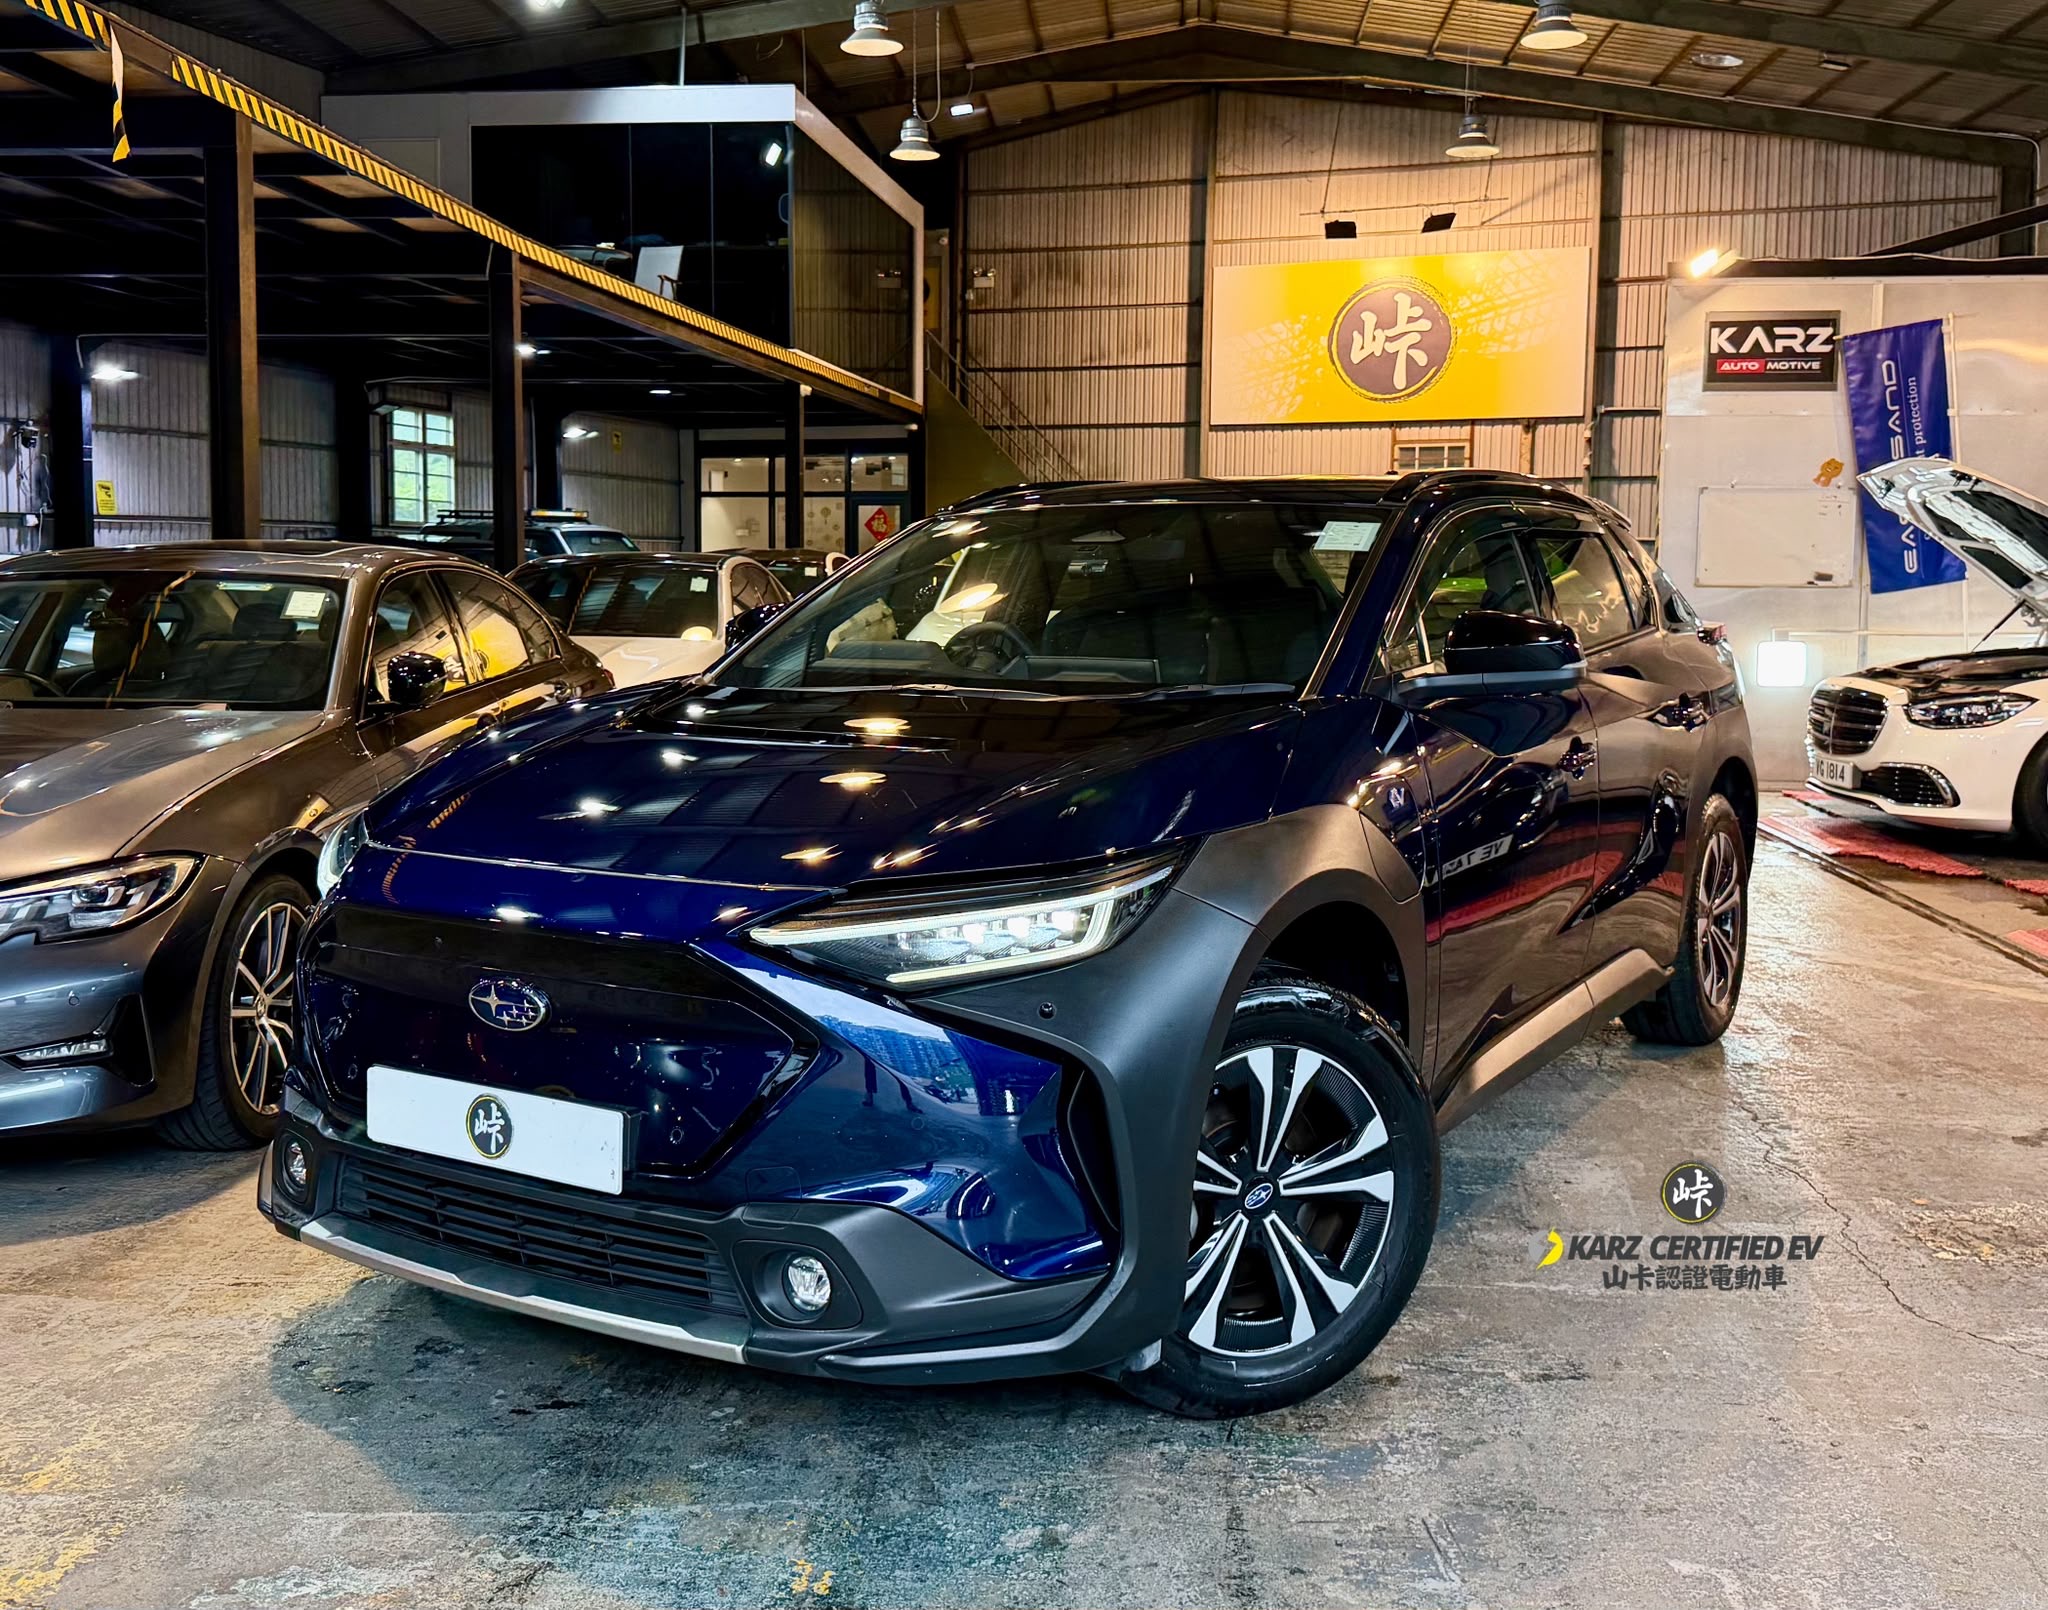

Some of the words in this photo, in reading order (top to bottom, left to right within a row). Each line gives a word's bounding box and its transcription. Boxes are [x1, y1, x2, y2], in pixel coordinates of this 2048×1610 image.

[1709, 326, 1834, 354] KARZ
[1720, 361, 1760, 371] AUTO
[1766, 361, 1821, 370] MOTIVE
[1907, 377, 1927, 445] protection
[1826, 761, 1845, 783] 1814
